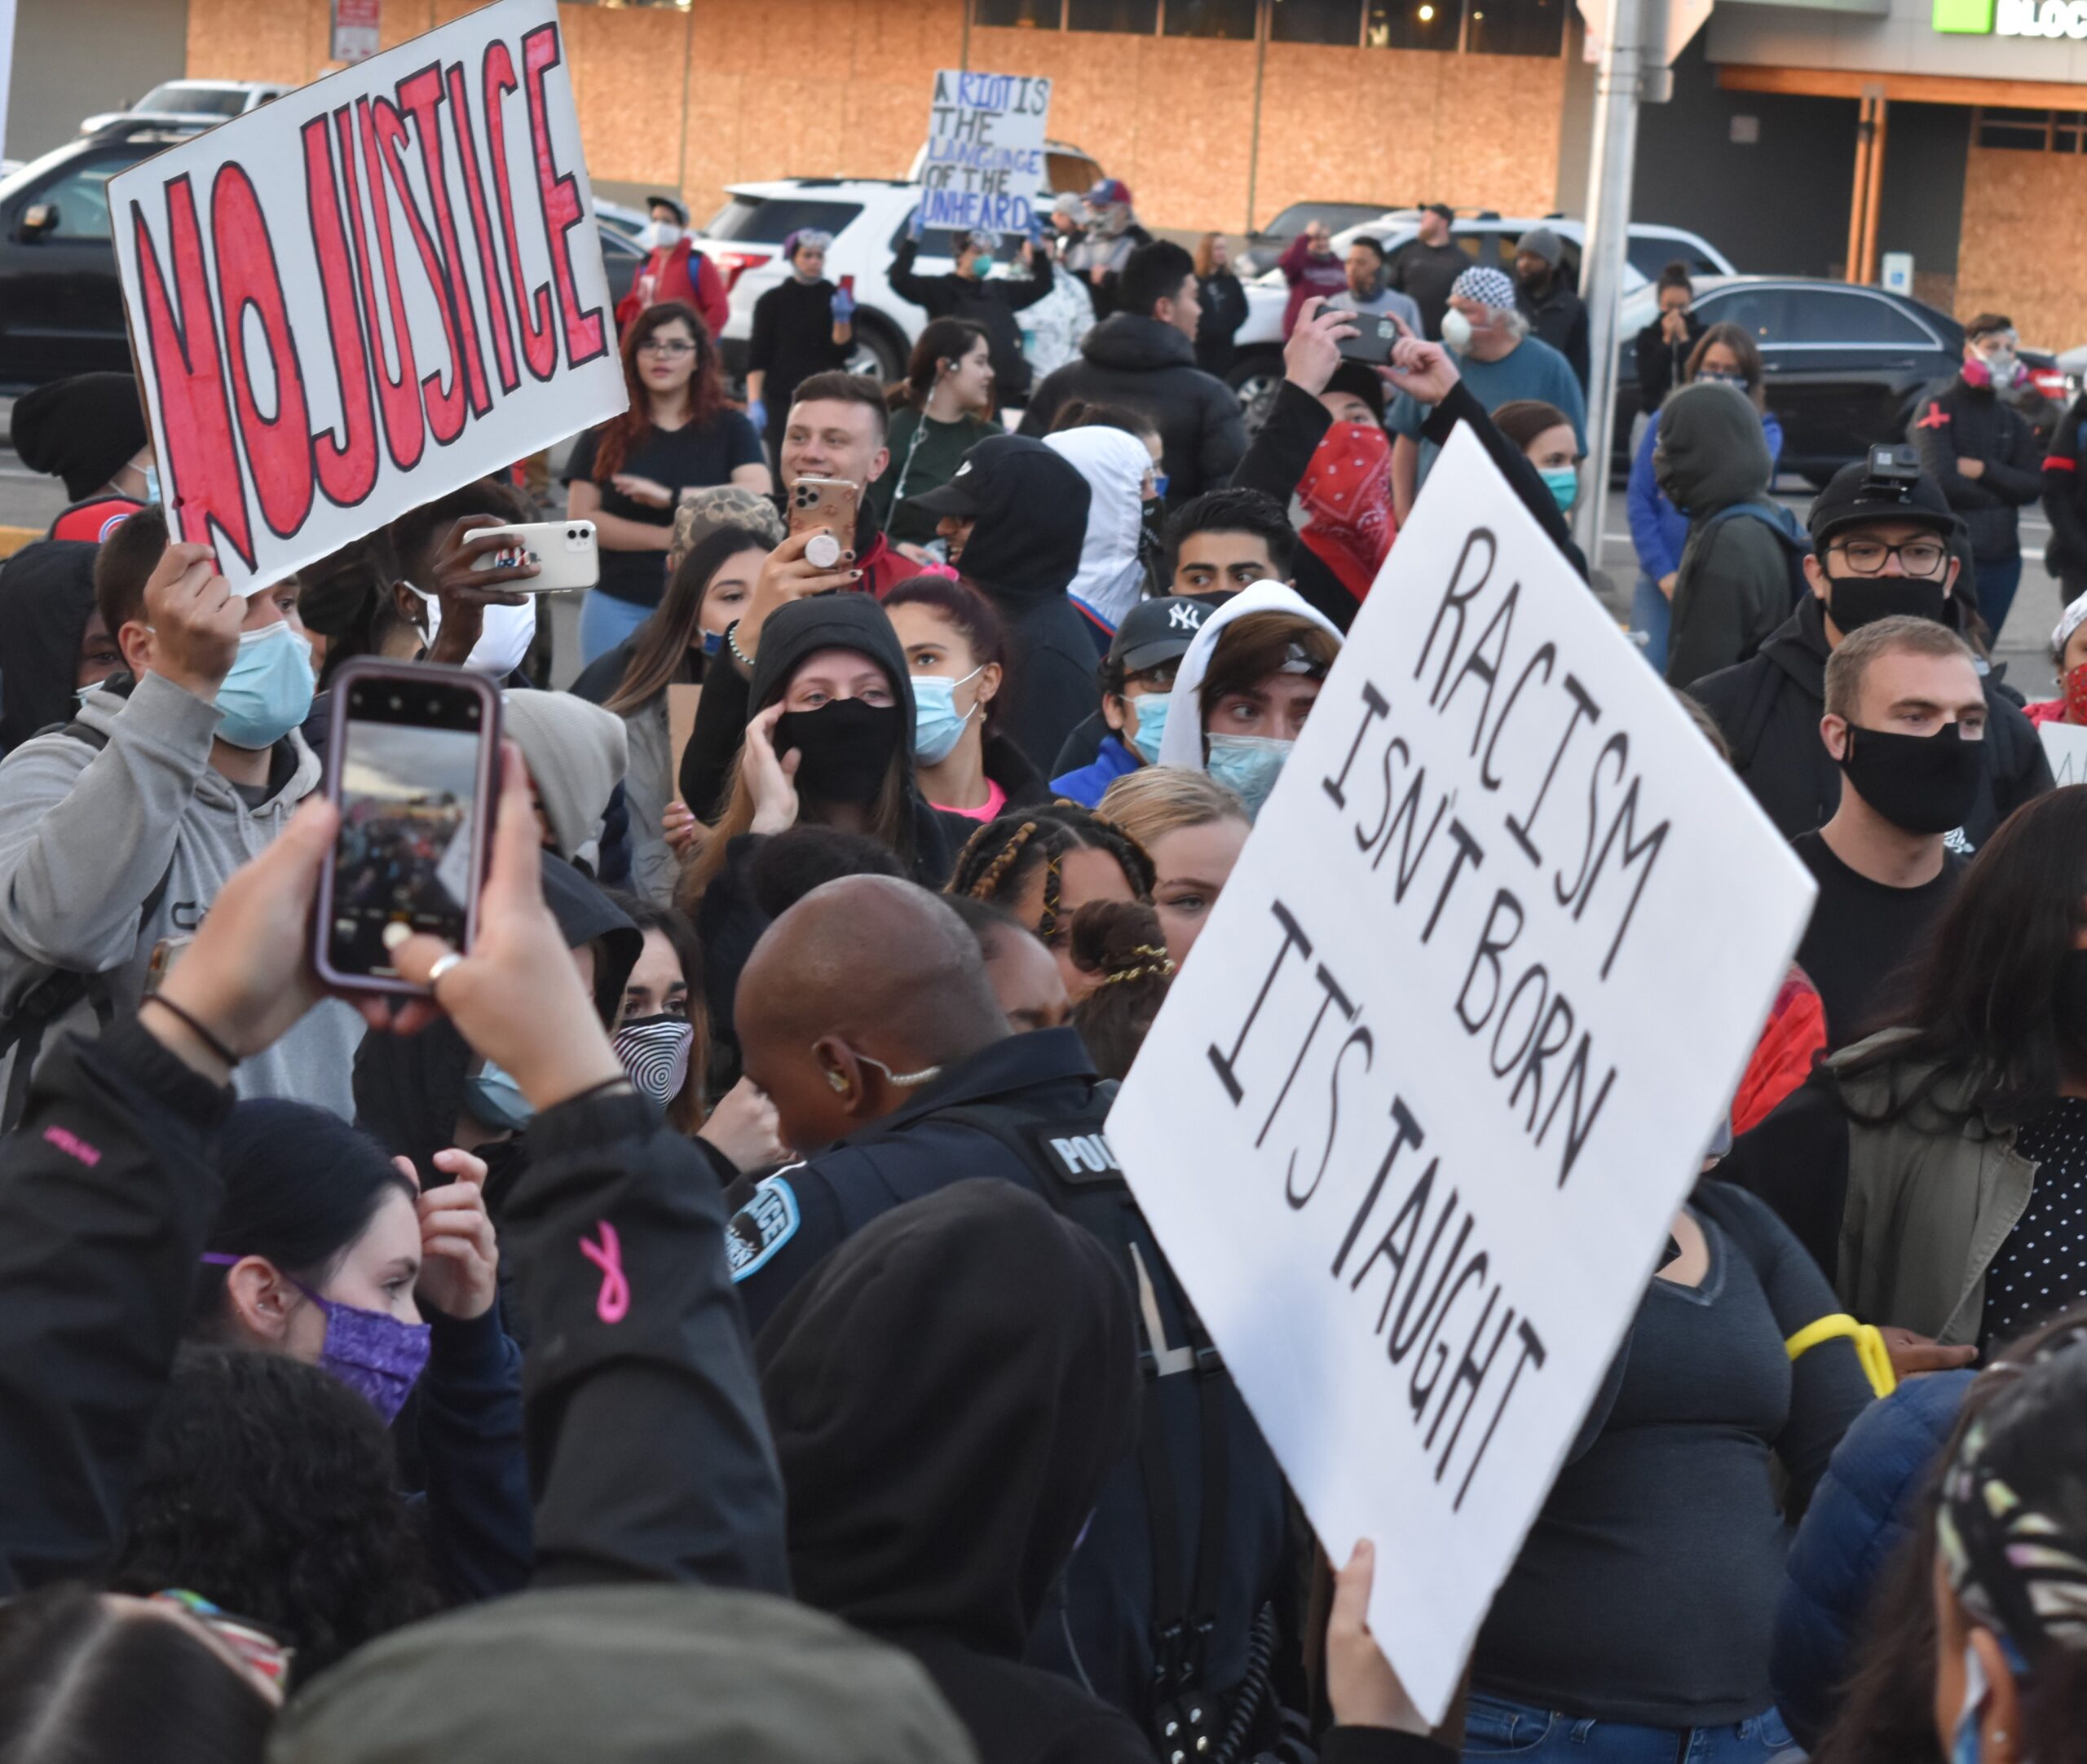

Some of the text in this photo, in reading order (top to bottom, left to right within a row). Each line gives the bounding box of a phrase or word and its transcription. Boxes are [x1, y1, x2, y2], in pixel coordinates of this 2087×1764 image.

[934, 71, 1048, 116] A RIOT IS
[933, 107, 1003, 147] THE
[928, 136, 1043, 175] LANGUAGE
[926, 165, 1011, 197] OF THE
[923, 189, 1032, 230] UNHEARD
[130, 21, 609, 576] NO JUSTICE
[1168, 602, 1201, 629] NY
[1414, 526, 1673, 981] RACISM
[1321, 681, 1617, 1189] ISN'T BORN
[1049, 1133, 1122, 1174] POL
[746, 1187, 788, 1248] LICE
[1207, 899, 1547, 1514] IT'S TAUGHT
